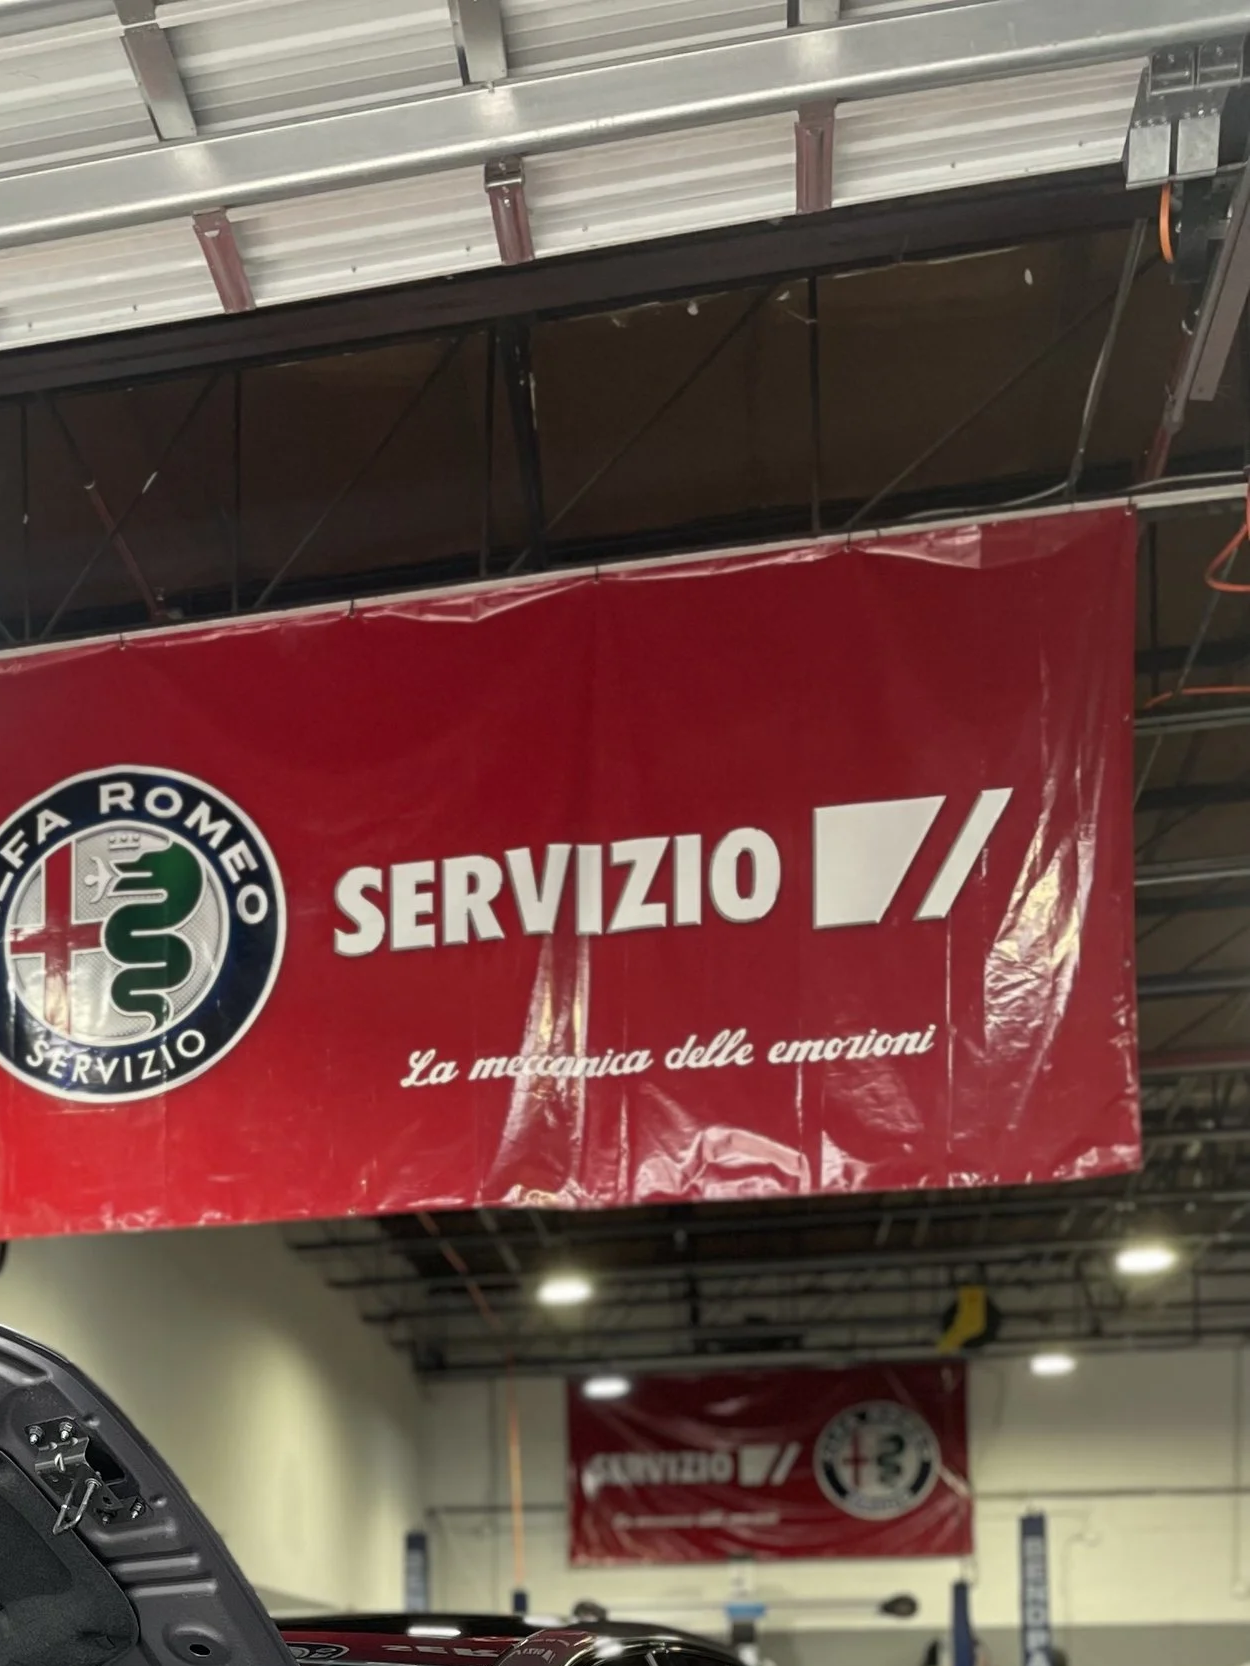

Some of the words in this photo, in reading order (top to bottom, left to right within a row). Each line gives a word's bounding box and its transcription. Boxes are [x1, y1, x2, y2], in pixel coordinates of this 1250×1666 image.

[99, 781, 268, 924] ROMEO
[334, 827, 781, 957] SERVIZIO
[26, 1029, 206, 1085] SERVIZIO
[400, 1049, 458, 1087] La
[468, 1049, 653, 1080] meccanica
[664, 1028, 753, 1070] delle
[767, 1024, 937, 1063] emozioni
